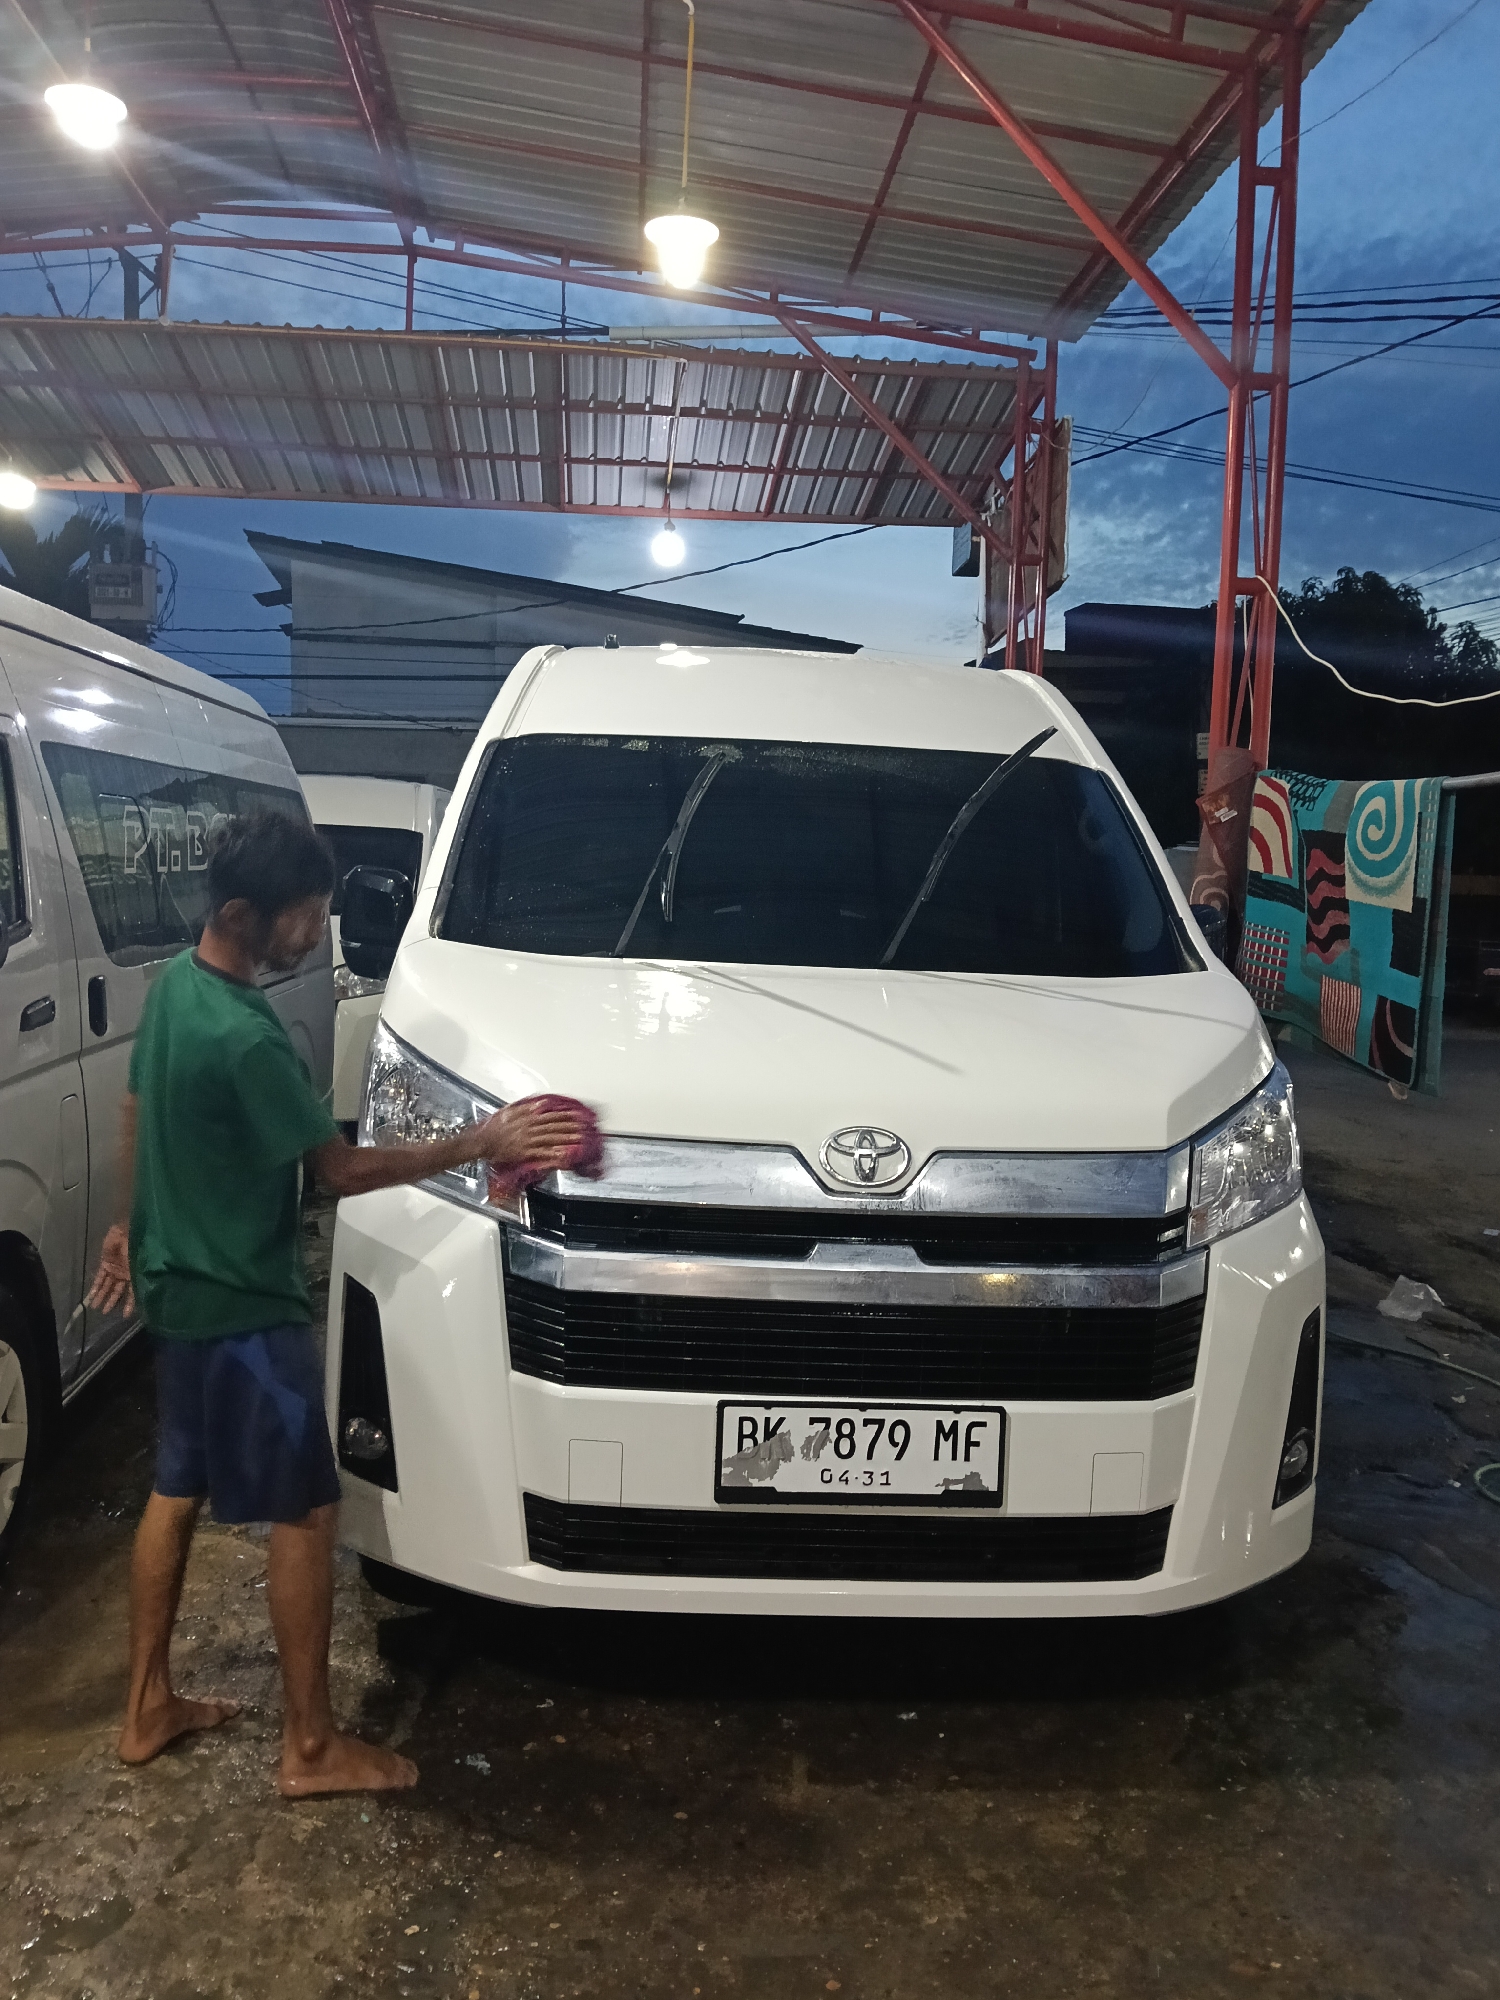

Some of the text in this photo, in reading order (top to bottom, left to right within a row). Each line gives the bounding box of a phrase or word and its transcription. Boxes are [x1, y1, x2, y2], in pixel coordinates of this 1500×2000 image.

[737, 1416, 988, 1462] BK 7879 MF
